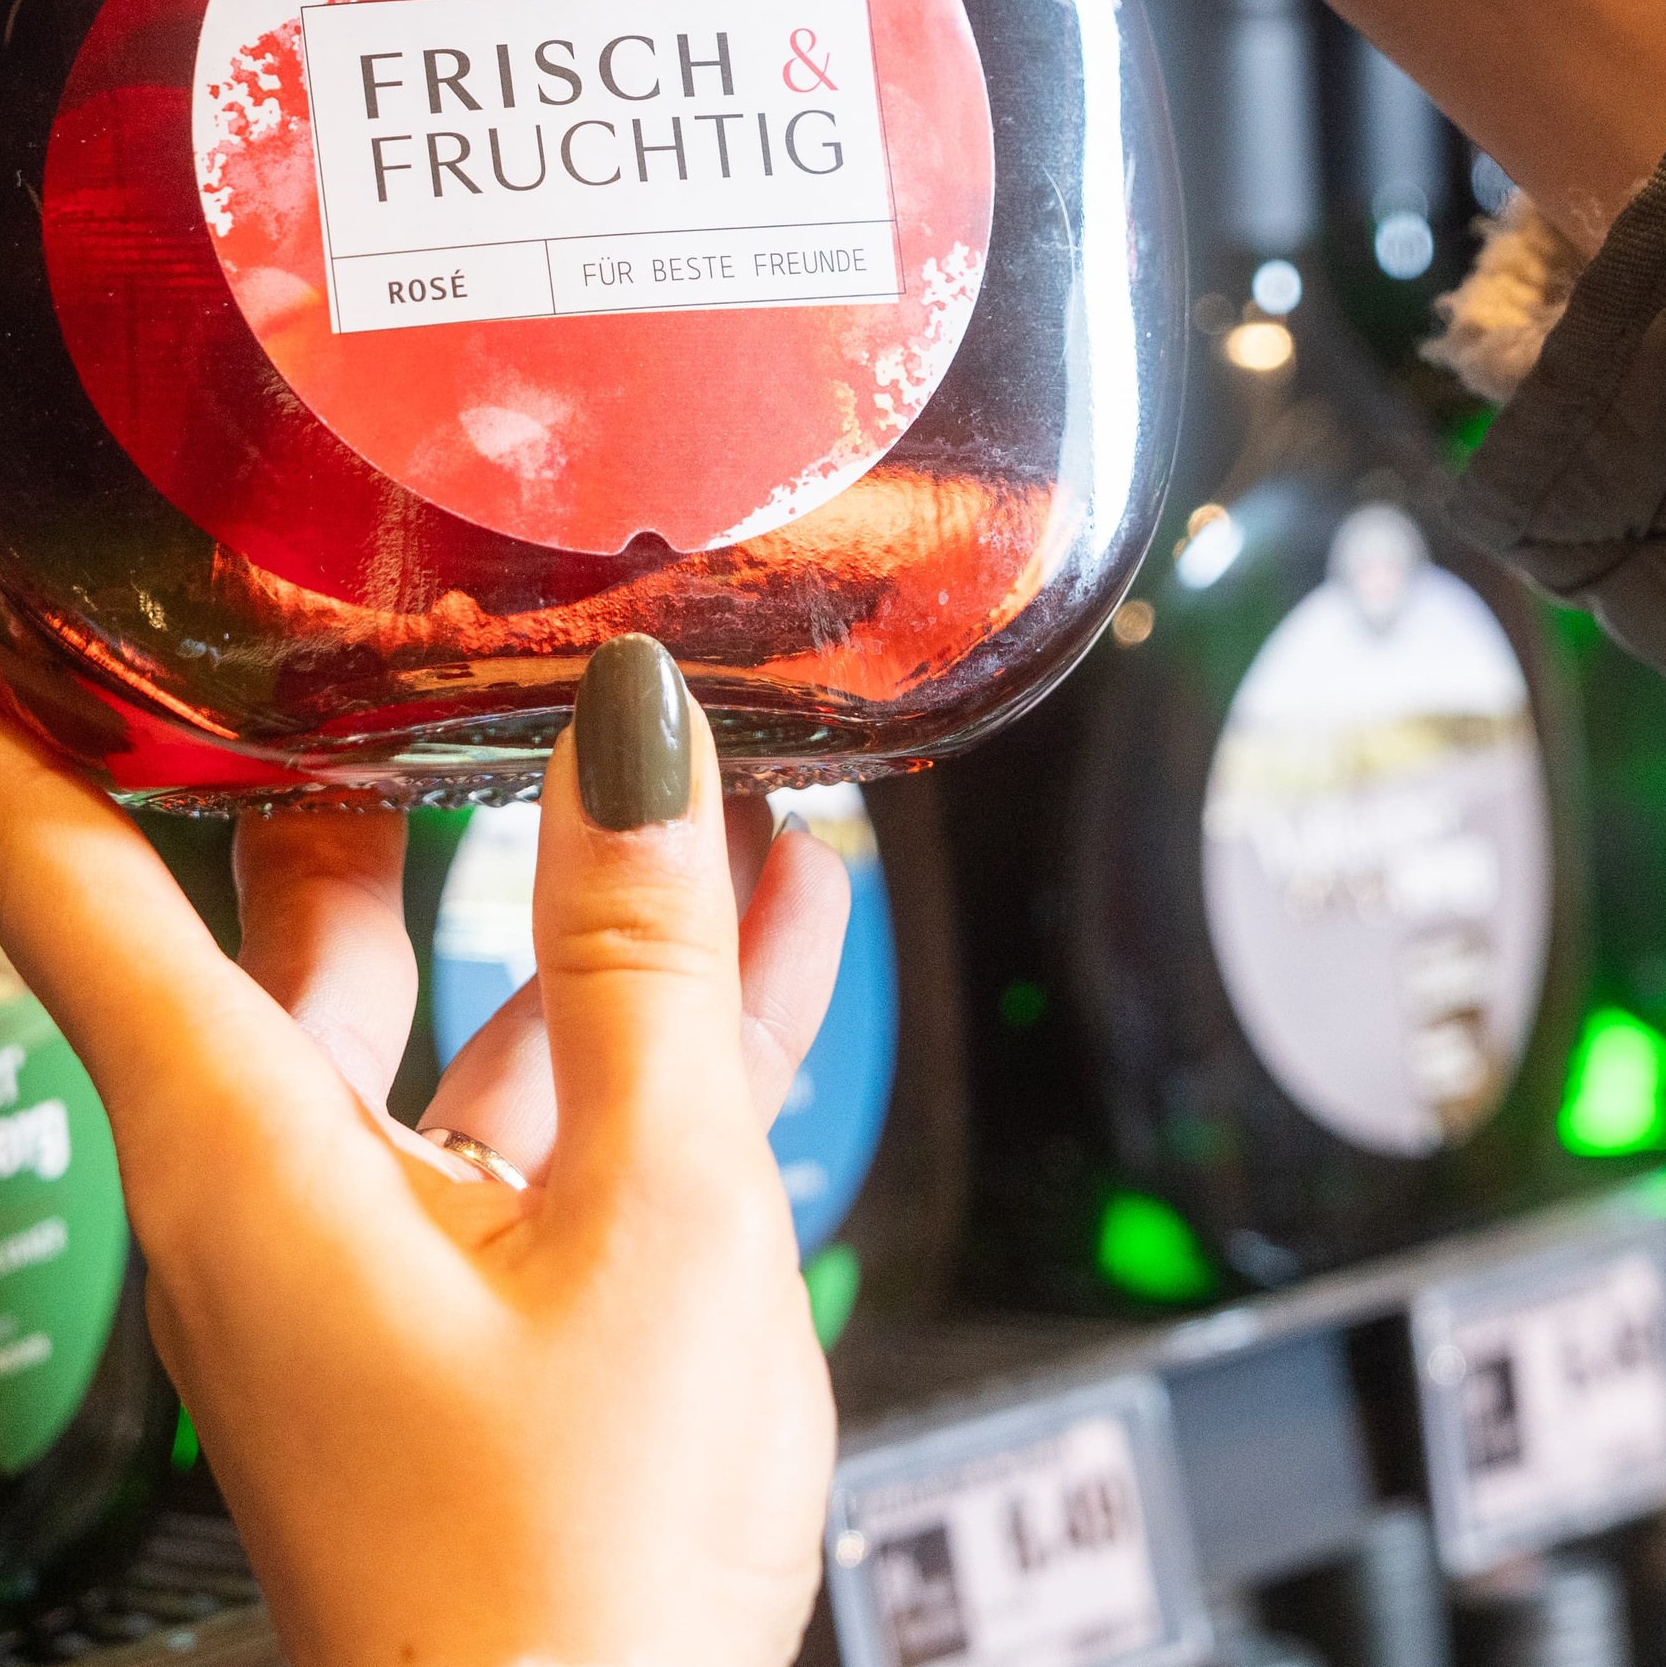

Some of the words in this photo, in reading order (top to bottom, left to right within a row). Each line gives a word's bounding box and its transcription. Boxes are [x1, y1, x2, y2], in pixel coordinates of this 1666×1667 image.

[359, 32, 735, 119] FRISCH
[782, 28, 839, 93] &
[370, 109, 844, 202] FRUCHTIG
[388, 269, 469, 305] ROSÉ
[582, 256, 634, 287] FÜR
[652, 256, 735, 283] BESTE
[753, 248, 867, 278] FREUNDE
